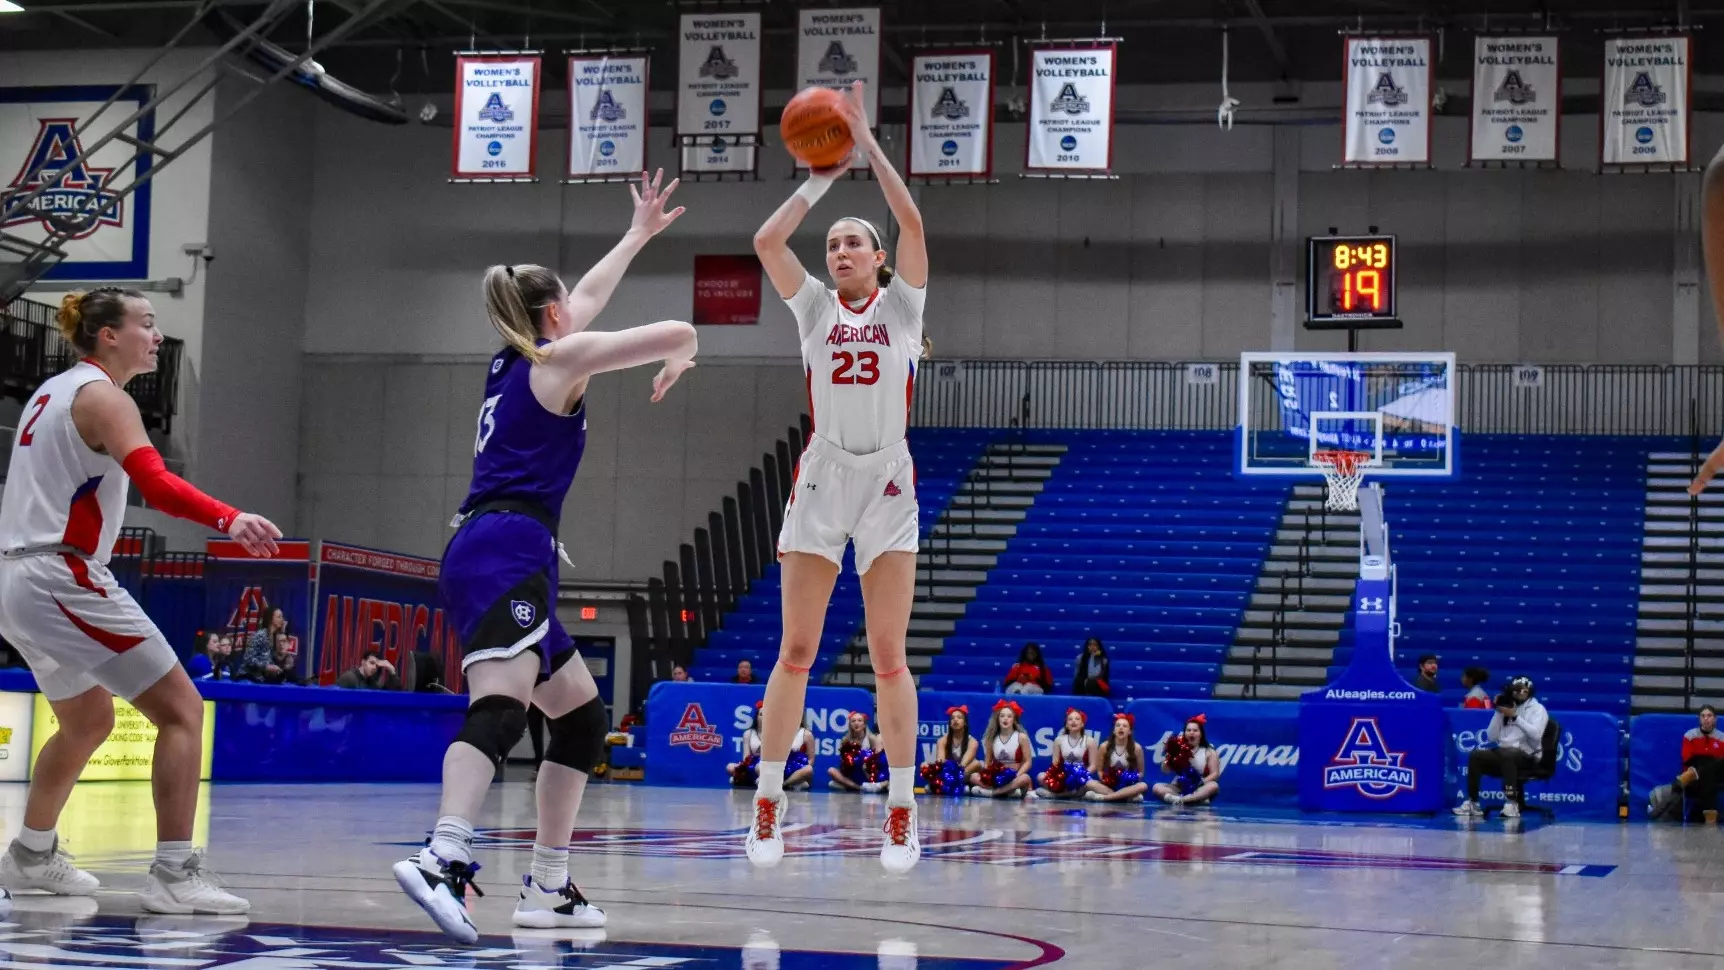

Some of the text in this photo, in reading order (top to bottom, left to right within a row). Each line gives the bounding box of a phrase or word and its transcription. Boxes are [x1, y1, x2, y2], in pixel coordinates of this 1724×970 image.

[812, 14, 864, 23] WOMEN'S
[693, 19, 745, 29] WOMEN'S
[804, 26, 874, 36] VOLLEYBALL
[685, 31, 756, 41] VOLLEYBALL
[1360, 46, 1414, 55] WOMEN'S
[1486, 43, 1542, 52] WOMEN'S
[1616, 45, 1672, 54] WOMEN'S
[1044, 57, 1097, 65] WOMEN'S
[1352, 59, 1426, 67] VOLLEYBALL
[1478, 56, 1554, 65] VOLLEYBALL
[1608, 57, 1684, 66] VOLLEYBALL
[924, 61, 976, 71] WOMEN'S
[474, 68, 520, 76] WOMEN'S
[1036, 69, 1108, 77] VOLLEYBALL
[916, 73, 987, 82] VOLLEYBALL
[466, 79, 531, 87] VOLLEYBALL
[704, 120, 731, 129] 2017
[482, 160, 506, 168] 2016
[938, 159, 960, 167] 2011
[1335, 244, 1388, 269] 8:43
[1344, 270, 1381, 310] 19
[831, 350, 881, 386] 23
[940, 366, 956, 376] 107
[19, 393, 51, 447] 2
[326, 548, 367, 565] CHARACTER
[368, 554, 394, 569] FORGED
[396, 560, 426, 574] THROUGH
[1325, 689, 1416, 700] AUeagles.com
[129, 732, 144, 742] CODE
[672, 733, 721, 744] AMERICAN
[1329, 768, 1410, 783] AMERICAN
[1539, 792, 1585, 803] RESTON
